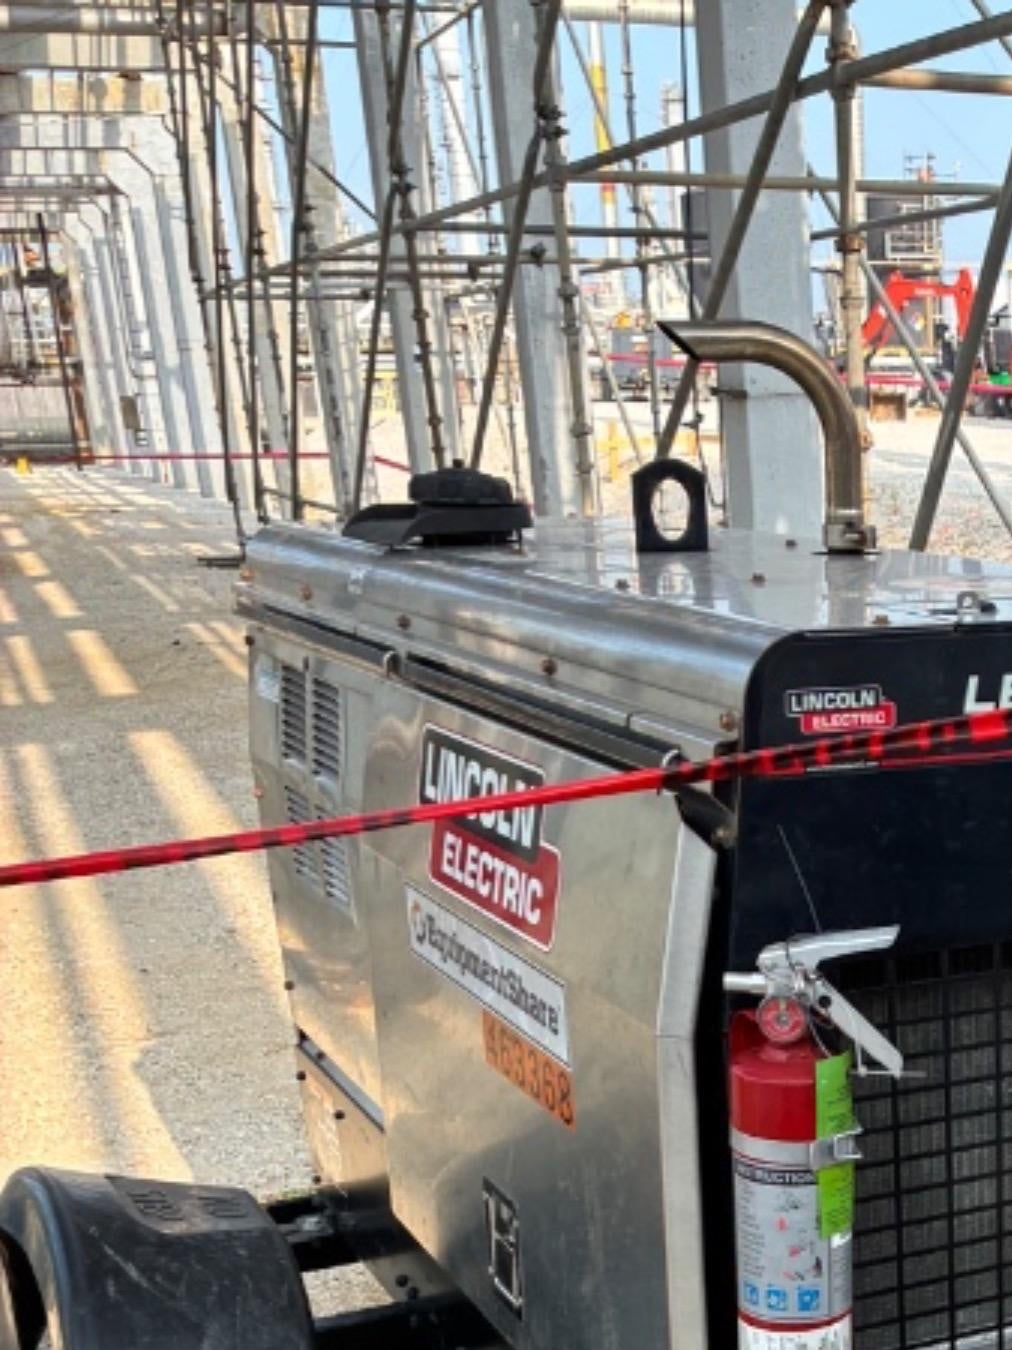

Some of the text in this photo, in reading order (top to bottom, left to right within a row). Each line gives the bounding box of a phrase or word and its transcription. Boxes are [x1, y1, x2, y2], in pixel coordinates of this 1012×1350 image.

[790, 689, 877, 713] LINCOLN
[812, 710, 887, 730] ELECTRIC
[424, 742, 536, 849] LINCOLN
[440, 831, 544, 925] ELECTRIC
